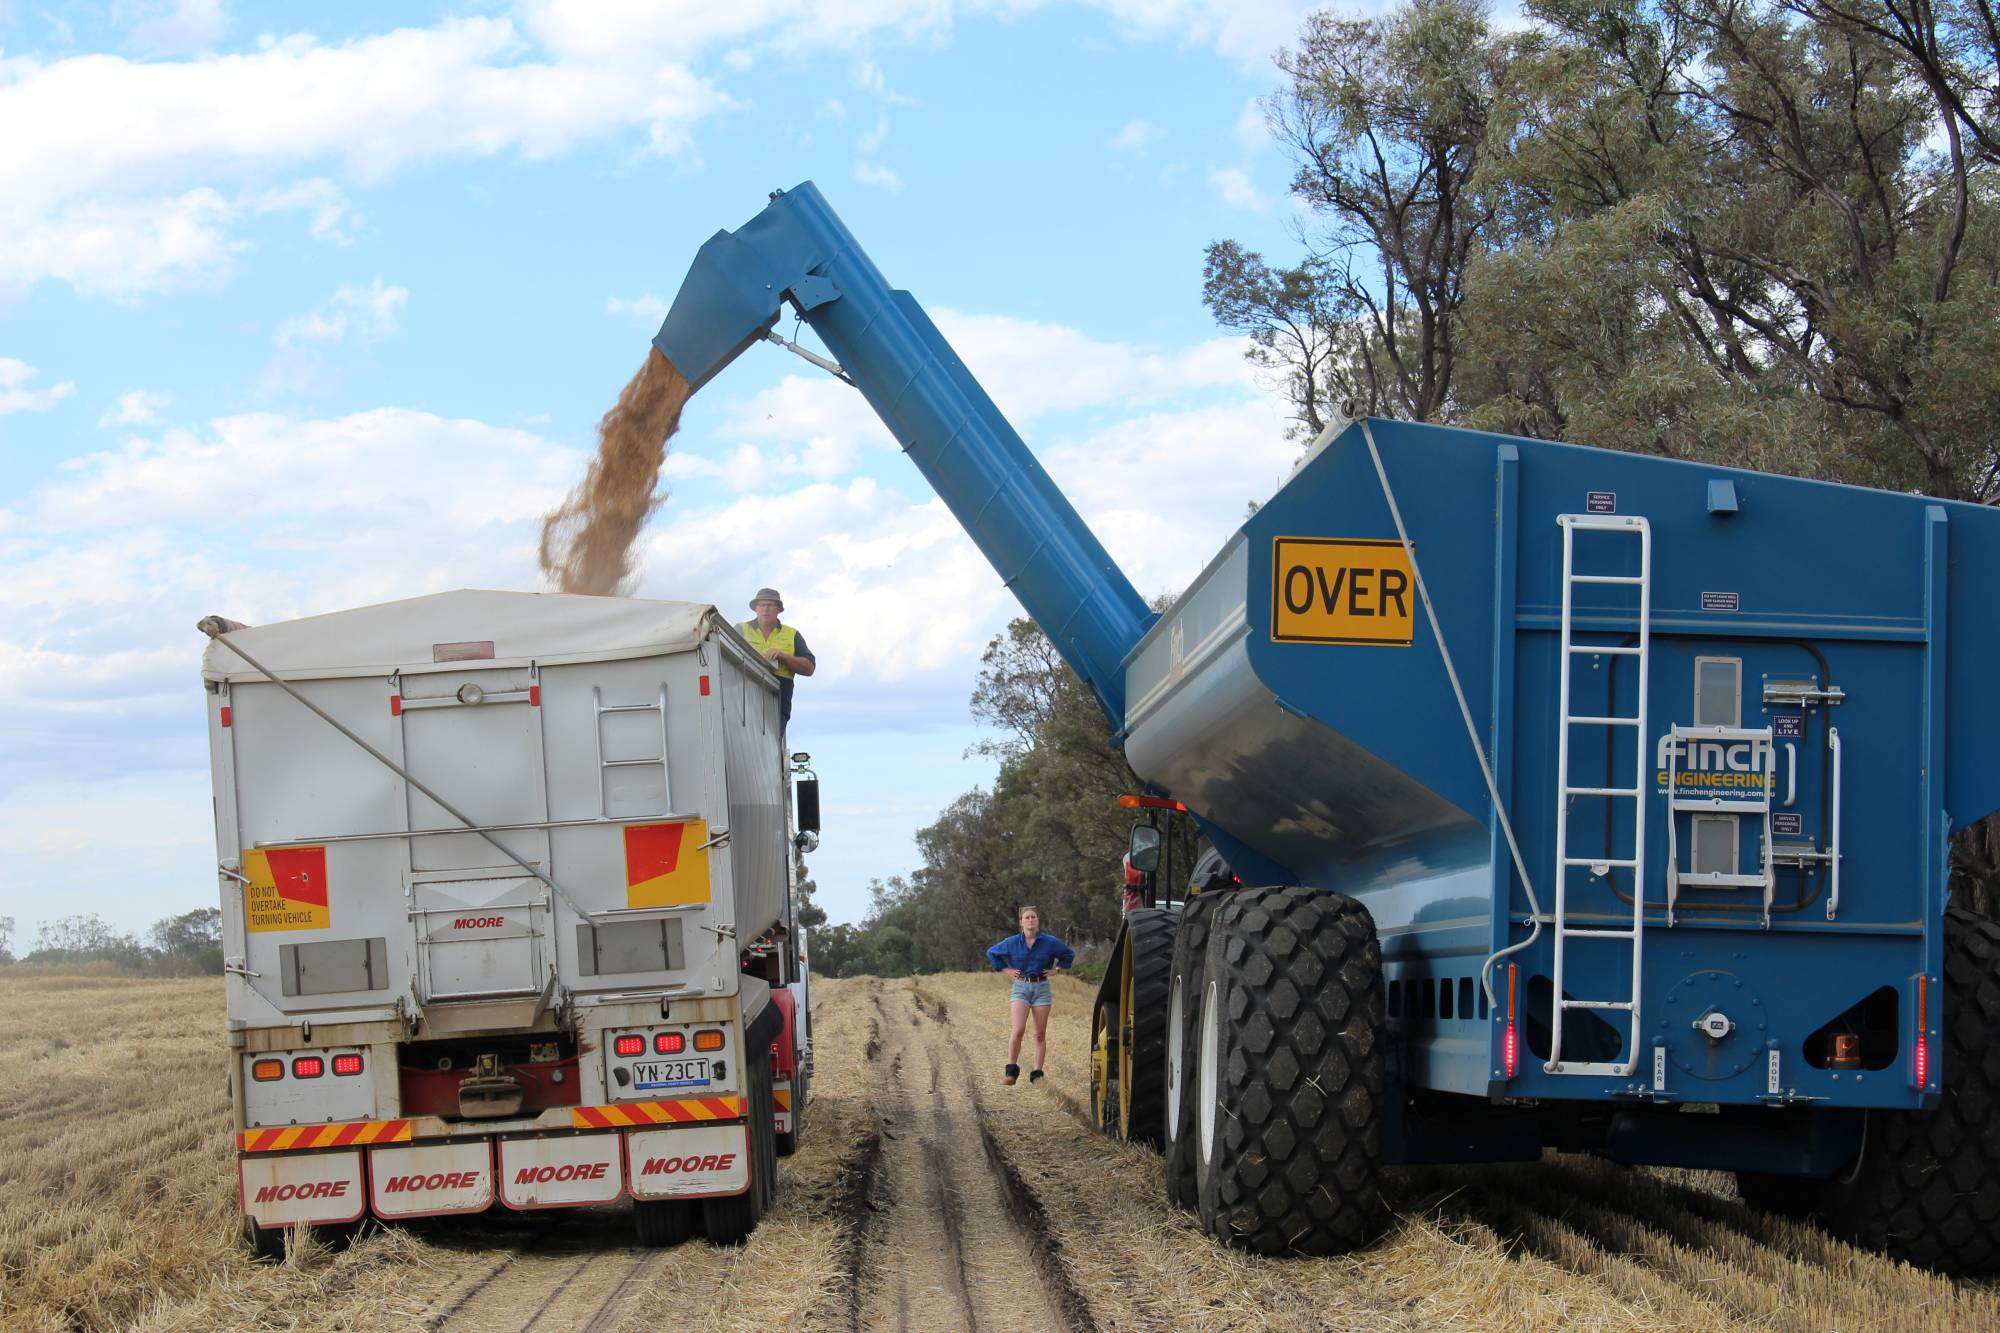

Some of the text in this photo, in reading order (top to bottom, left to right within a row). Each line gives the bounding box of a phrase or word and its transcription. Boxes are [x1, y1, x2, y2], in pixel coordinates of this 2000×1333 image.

[1285, 565, 1407, 617] OVER
[1657, 772, 1776, 788] ENGINEERING
[250, 886, 275, 898] DO NOT
[251, 899, 286, 912] OVERTAKE
[252, 911, 312, 926] TURNING VEHICLE
[453, 916, 505, 930] MOORE
[514, 1162, 609, 1185] MOORE
[641, 1153, 737, 1175] MOORE
[255, 1180, 350, 1203] MOORE
[384, 1171, 480, 1193] MOORE
